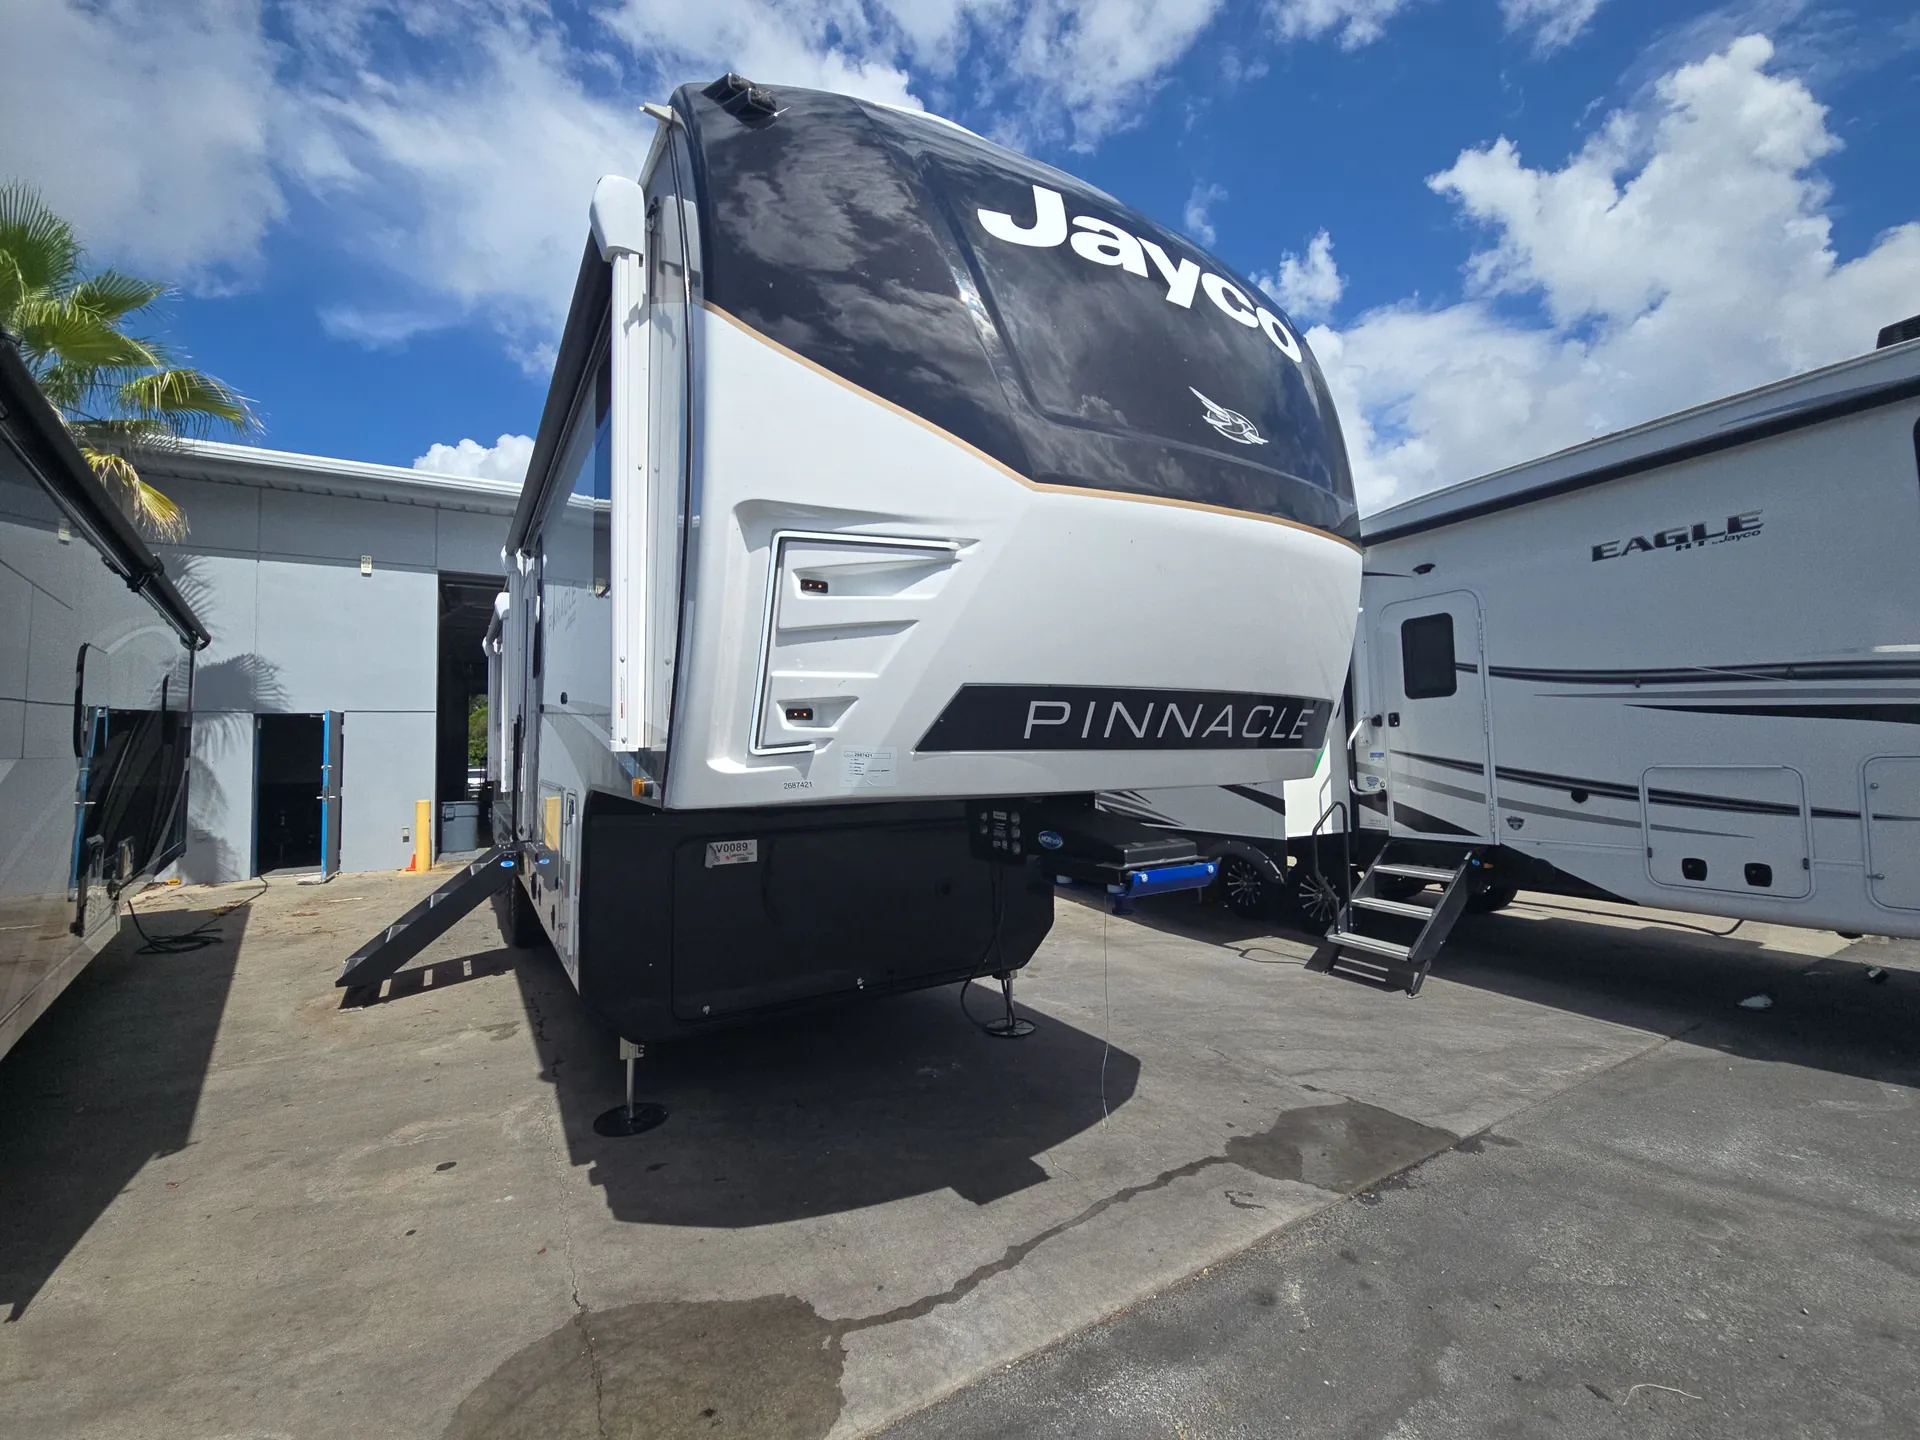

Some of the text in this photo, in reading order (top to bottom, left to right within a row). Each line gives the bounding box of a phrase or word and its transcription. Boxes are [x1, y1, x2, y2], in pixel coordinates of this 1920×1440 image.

[977, 184, 1302, 363] Jayco
[1591, 509, 1764, 562] EAGLE
[1719, 530, 1762, 545] Jayco
[1023, 699, 1315, 739] PINNACLE
[783, 780, 813, 790] 2687421
[715, 842, 748, 853] V0089
